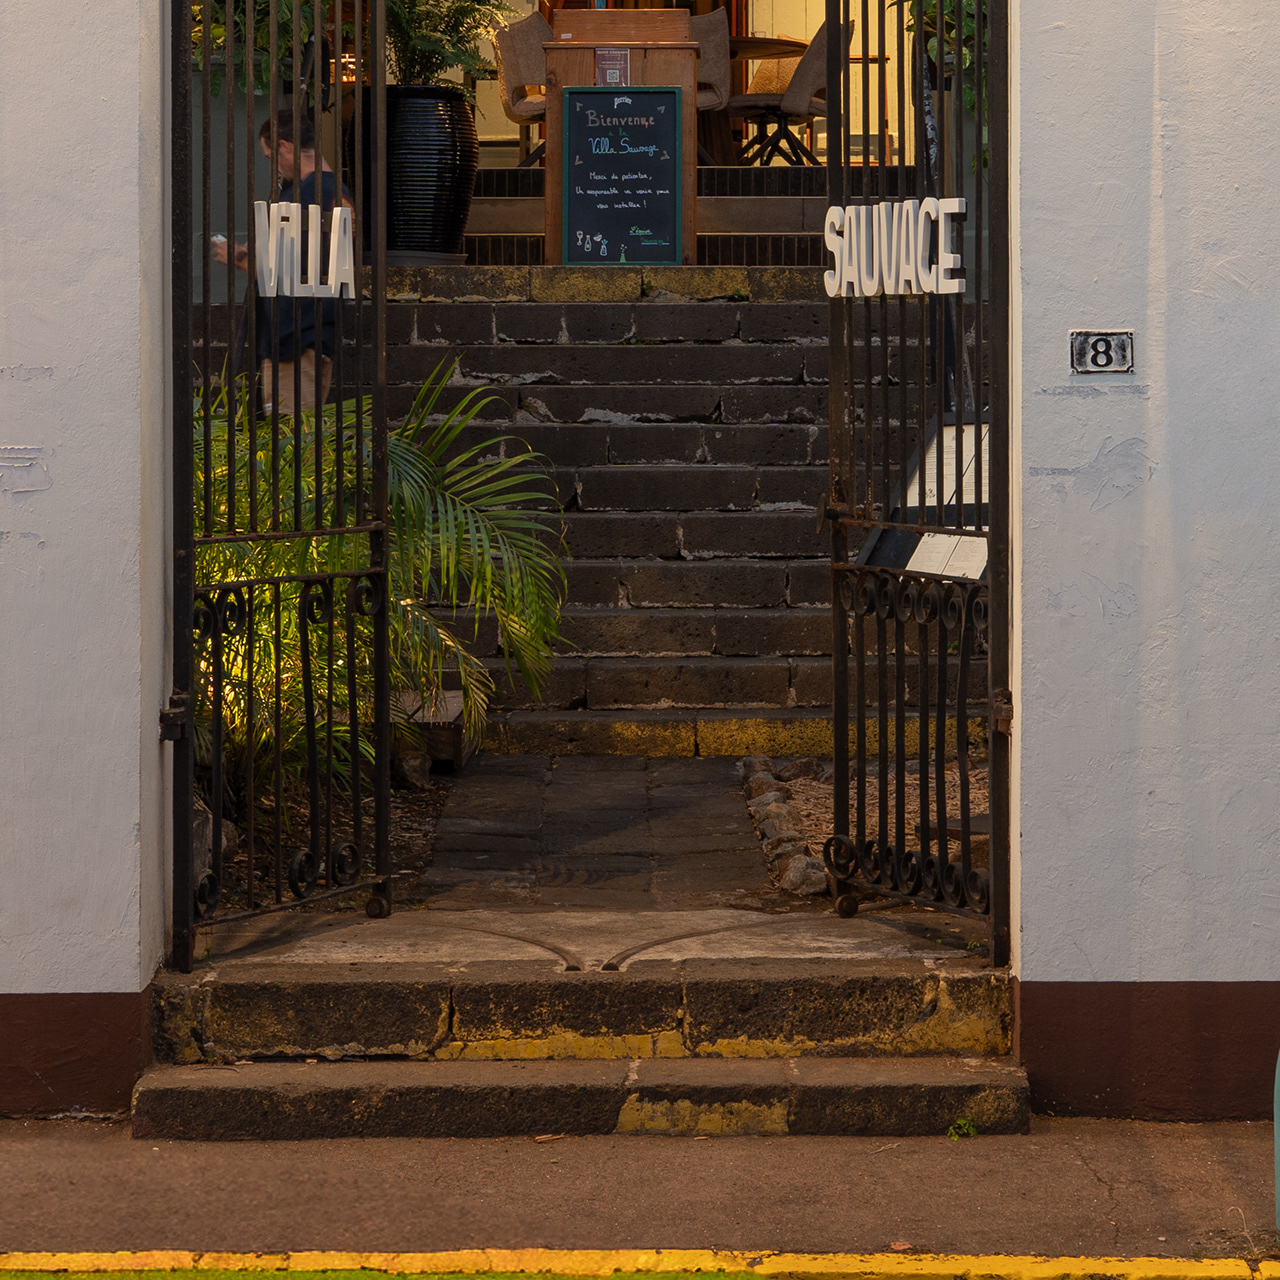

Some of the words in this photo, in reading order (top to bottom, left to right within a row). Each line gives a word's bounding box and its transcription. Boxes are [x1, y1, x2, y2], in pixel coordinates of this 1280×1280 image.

[585, 109, 655, 128] Bienvenue
[588, 137, 617, 154] Villa
[619, 137, 659, 157] Sauvage
[589, 171, 607, 180] Merci
[575, 186, 584, 195] Un
[823, 196, 968, 298] SAUVAGE
[1090, 337, 1114, 368] 8
